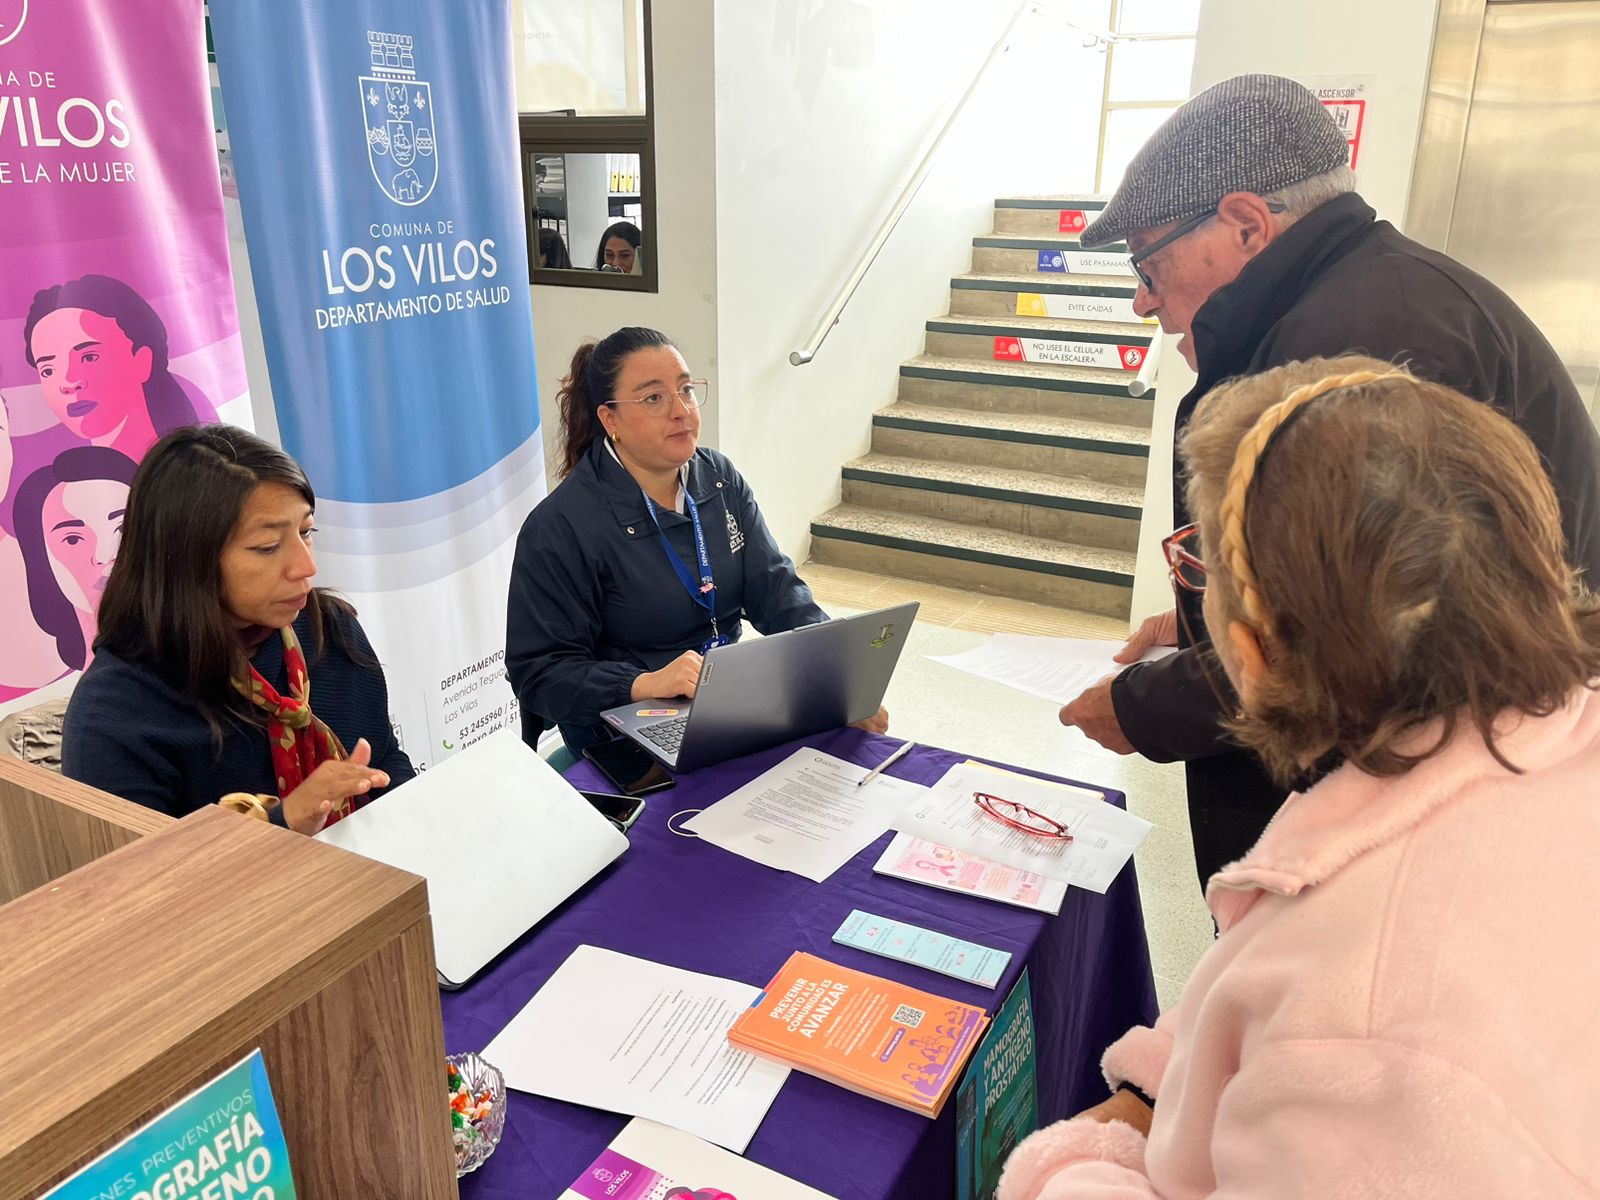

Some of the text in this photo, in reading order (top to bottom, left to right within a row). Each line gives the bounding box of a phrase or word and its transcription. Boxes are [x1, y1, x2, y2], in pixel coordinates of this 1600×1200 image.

[0, 70, 56, 88] A DE
[1317, 89, 1356, 98] ASCENSOR
[20, 162, 51, 183] LA
[60, 162, 136, 183] MUJER
[369, 221, 454, 238] COMUNA DE
[322, 238, 498, 295] LOS VILOS
[1080, 259, 1092, 267] USE
[315, 286, 511, 330] DEPARTAMENTO DE SALUD
[1068, 303, 1113, 313] EVITE CAÍDAS
[1039, 352, 1096, 363] EN LA ESCALERA
[1046, 343, 1062, 352] USES
[1073, 346, 1104, 355] CELULAR
[694, 523, 709, 566] DEPARTAMENTO
[441, 650, 505, 691] DEPARTAMENTO
[443, 681, 478, 708] Avenida
[444, 699, 479, 724] Los Vilos
[459, 727, 469, 740] 53
[470, 706, 503, 733] 2455960
[510, 698, 518, 710] 53
[509, 711, 518, 724] 51
[769, 978, 808, 1019] PREVENIR
[781, 996, 806, 1022] JUNTO
[805, 982, 819, 991] LA
[786, 978, 833, 1032] COMUNIDAD ES
[799, 983, 849, 1039] AVANZAR
[984, 997, 1029, 1076] MAMOGRAFÍA
[984, 1074, 989, 1095] Y
[142, 1088, 253, 1177] PREVENTIVOS
[604, 1184, 616, 1195] LOS
[614, 1170, 630, 1184] VILOS
